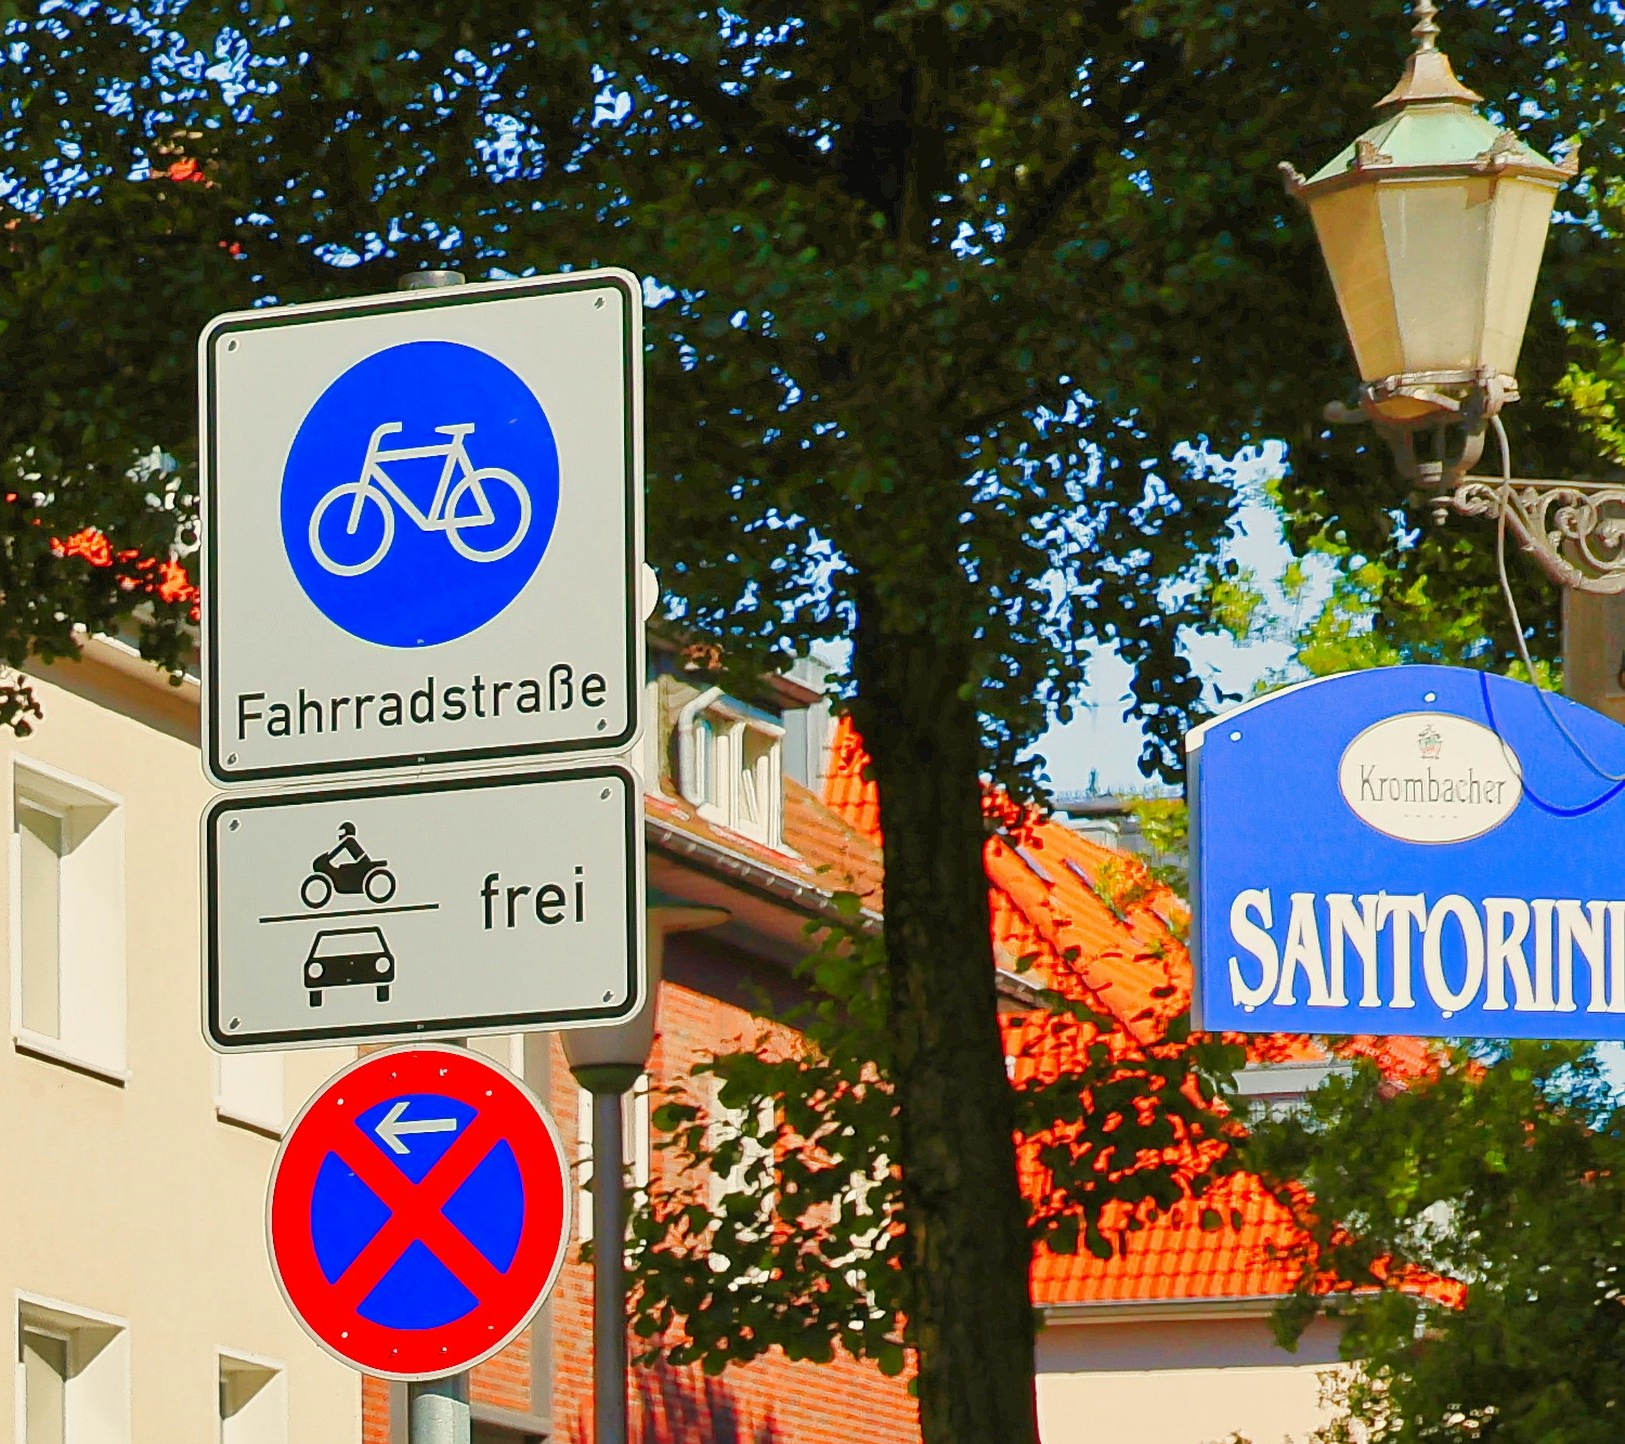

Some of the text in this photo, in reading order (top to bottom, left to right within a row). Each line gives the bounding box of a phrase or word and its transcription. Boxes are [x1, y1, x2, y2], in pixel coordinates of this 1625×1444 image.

[237, 662, 608, 741] Fahrradstraße
[1359, 763, 1507, 805] Krombacher
[480, 865, 585, 930] frei
[1228, 887, 1625, 1013] SANTORINI
